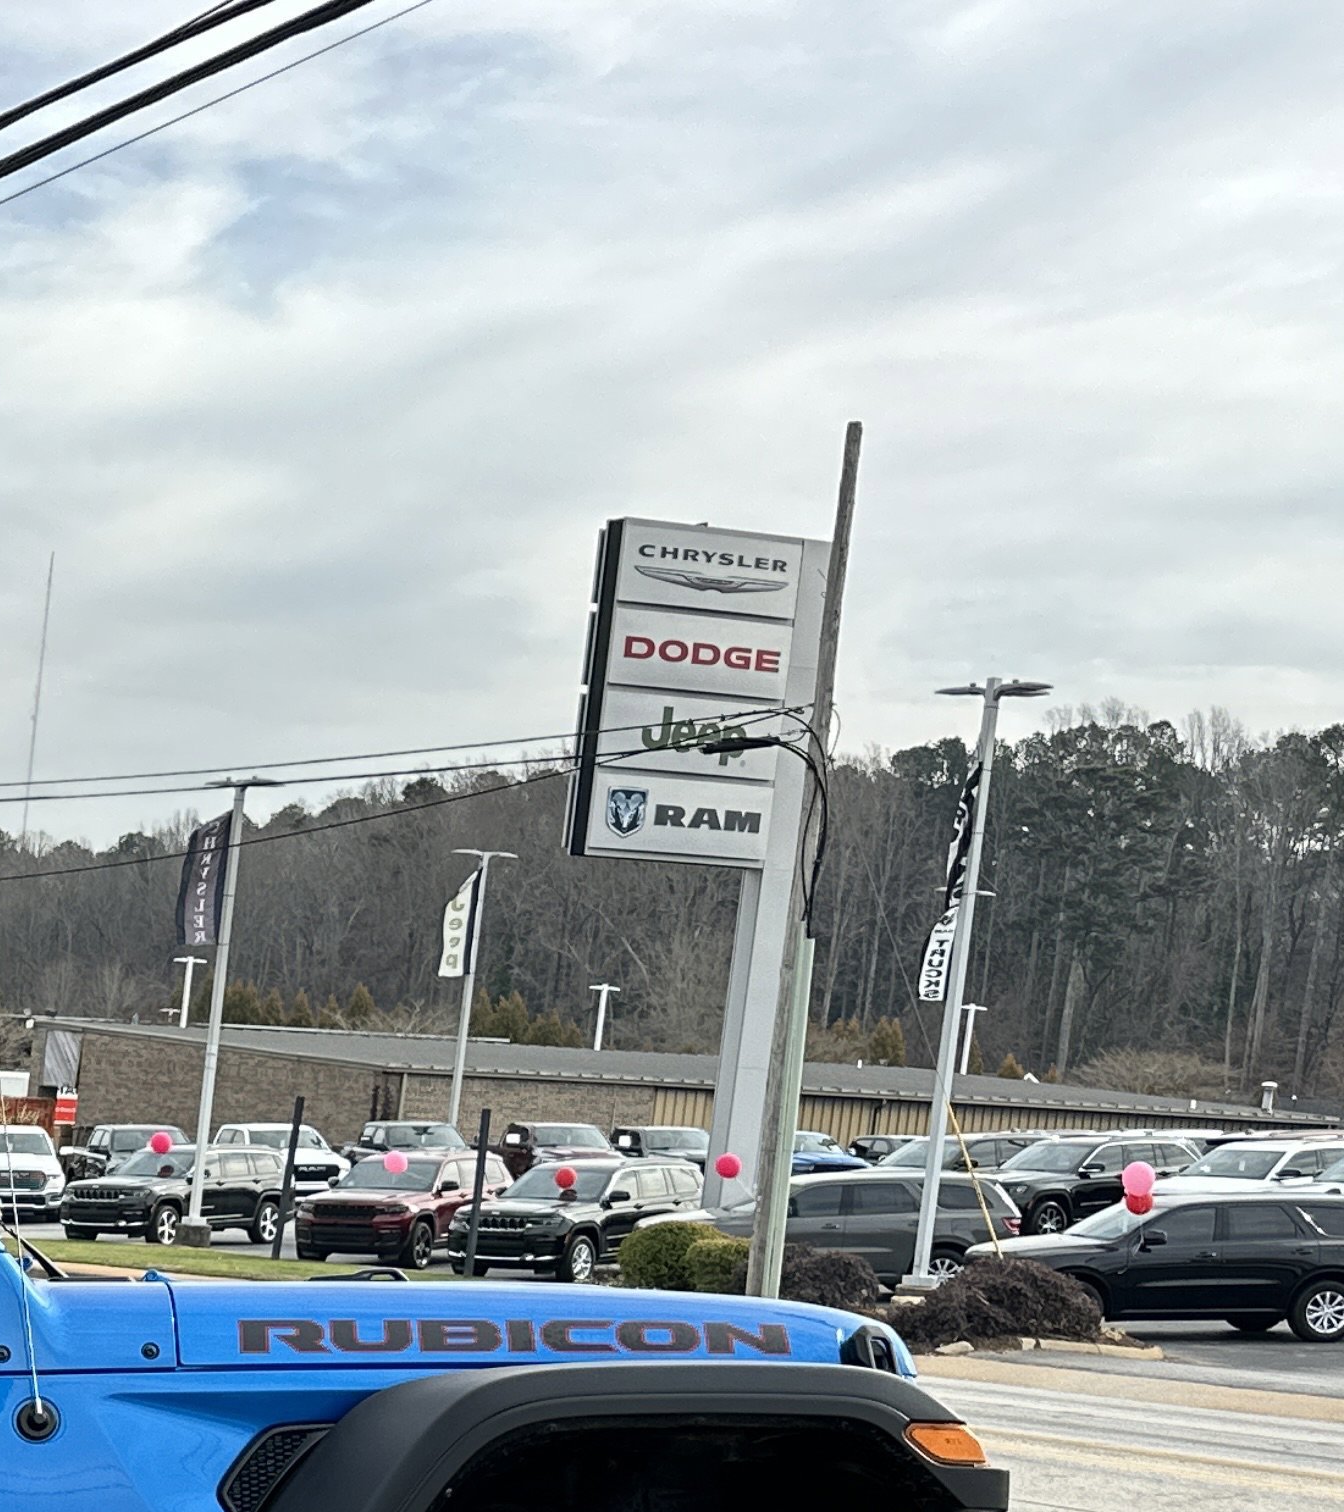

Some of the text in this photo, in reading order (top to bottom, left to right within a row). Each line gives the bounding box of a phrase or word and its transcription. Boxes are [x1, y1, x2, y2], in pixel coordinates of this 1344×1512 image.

[638, 544, 788, 573] CHRYSLER
[623, 635, 781, 673] DODGE
[641, 706, 747, 767] Jeep
[653, 803, 762, 834] RAM
[236, 1318, 792, 1355] RUBICON
